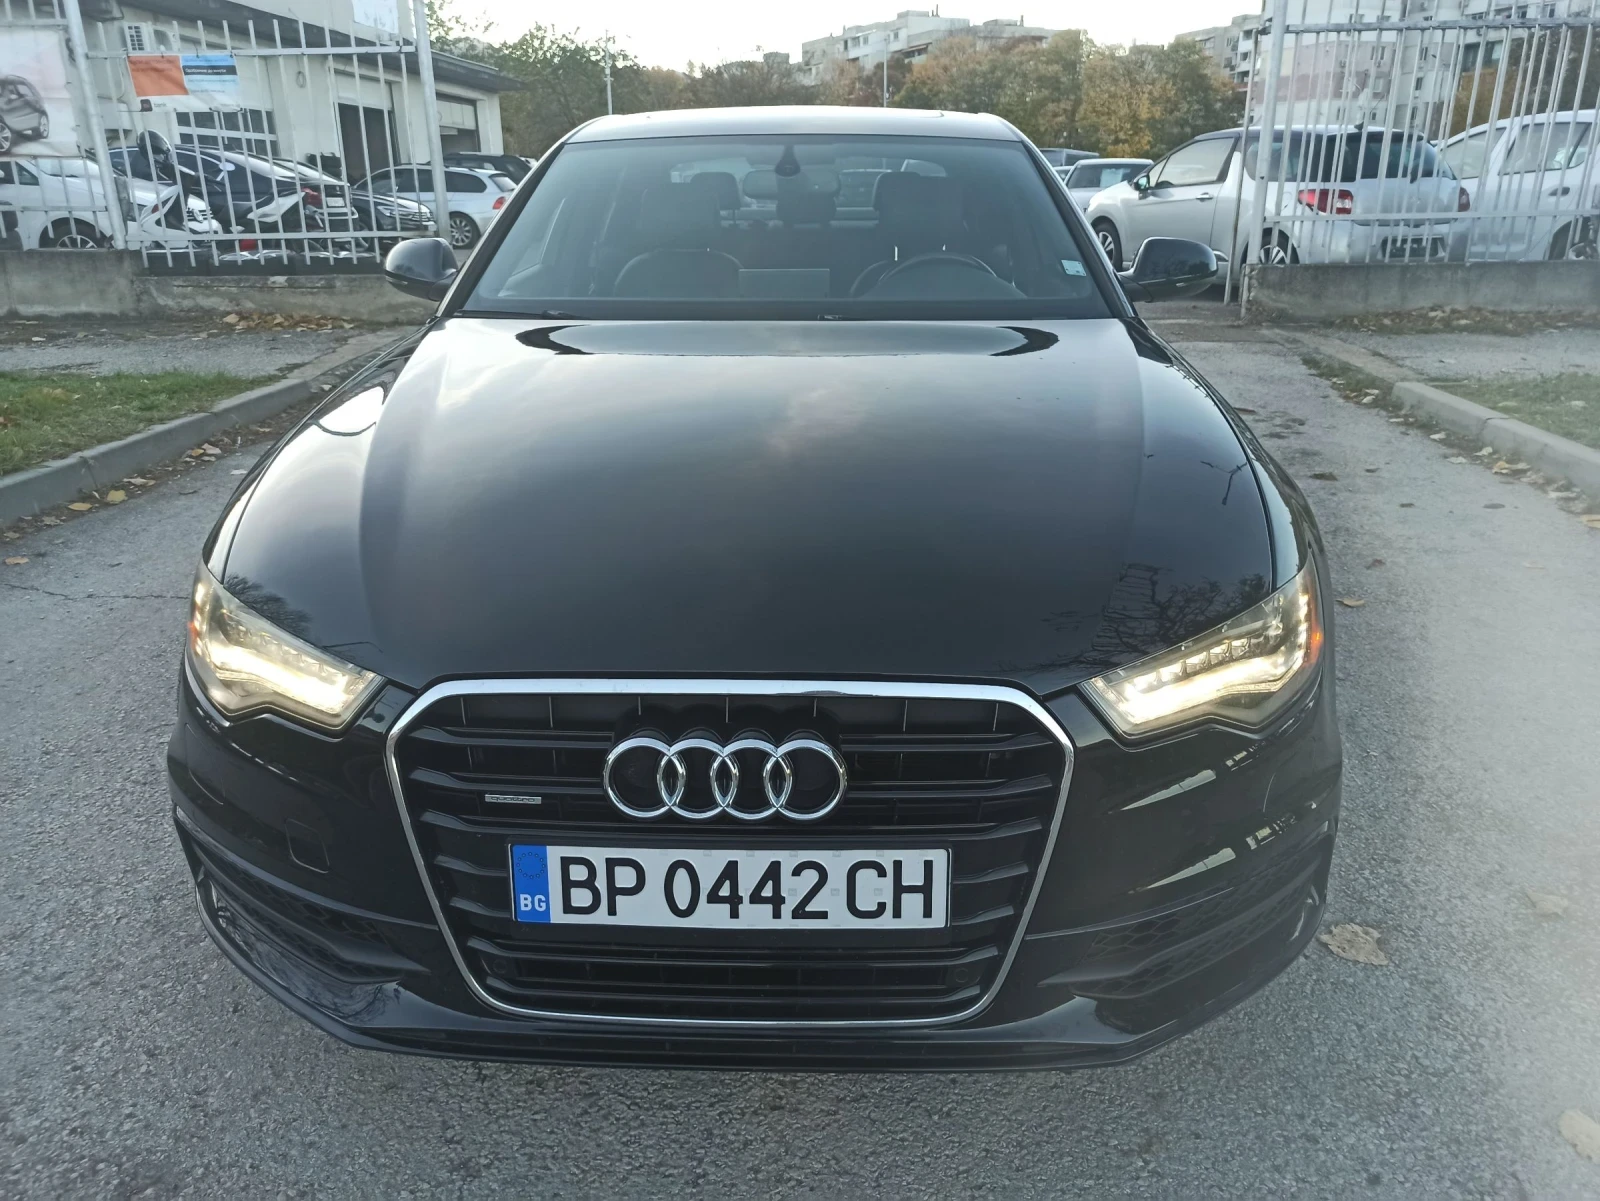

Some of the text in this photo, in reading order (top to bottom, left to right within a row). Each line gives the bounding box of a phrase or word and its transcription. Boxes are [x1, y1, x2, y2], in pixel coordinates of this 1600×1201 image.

[519, 893, 547, 912] BG
[560, 856, 934, 920] BP 0442 CH
